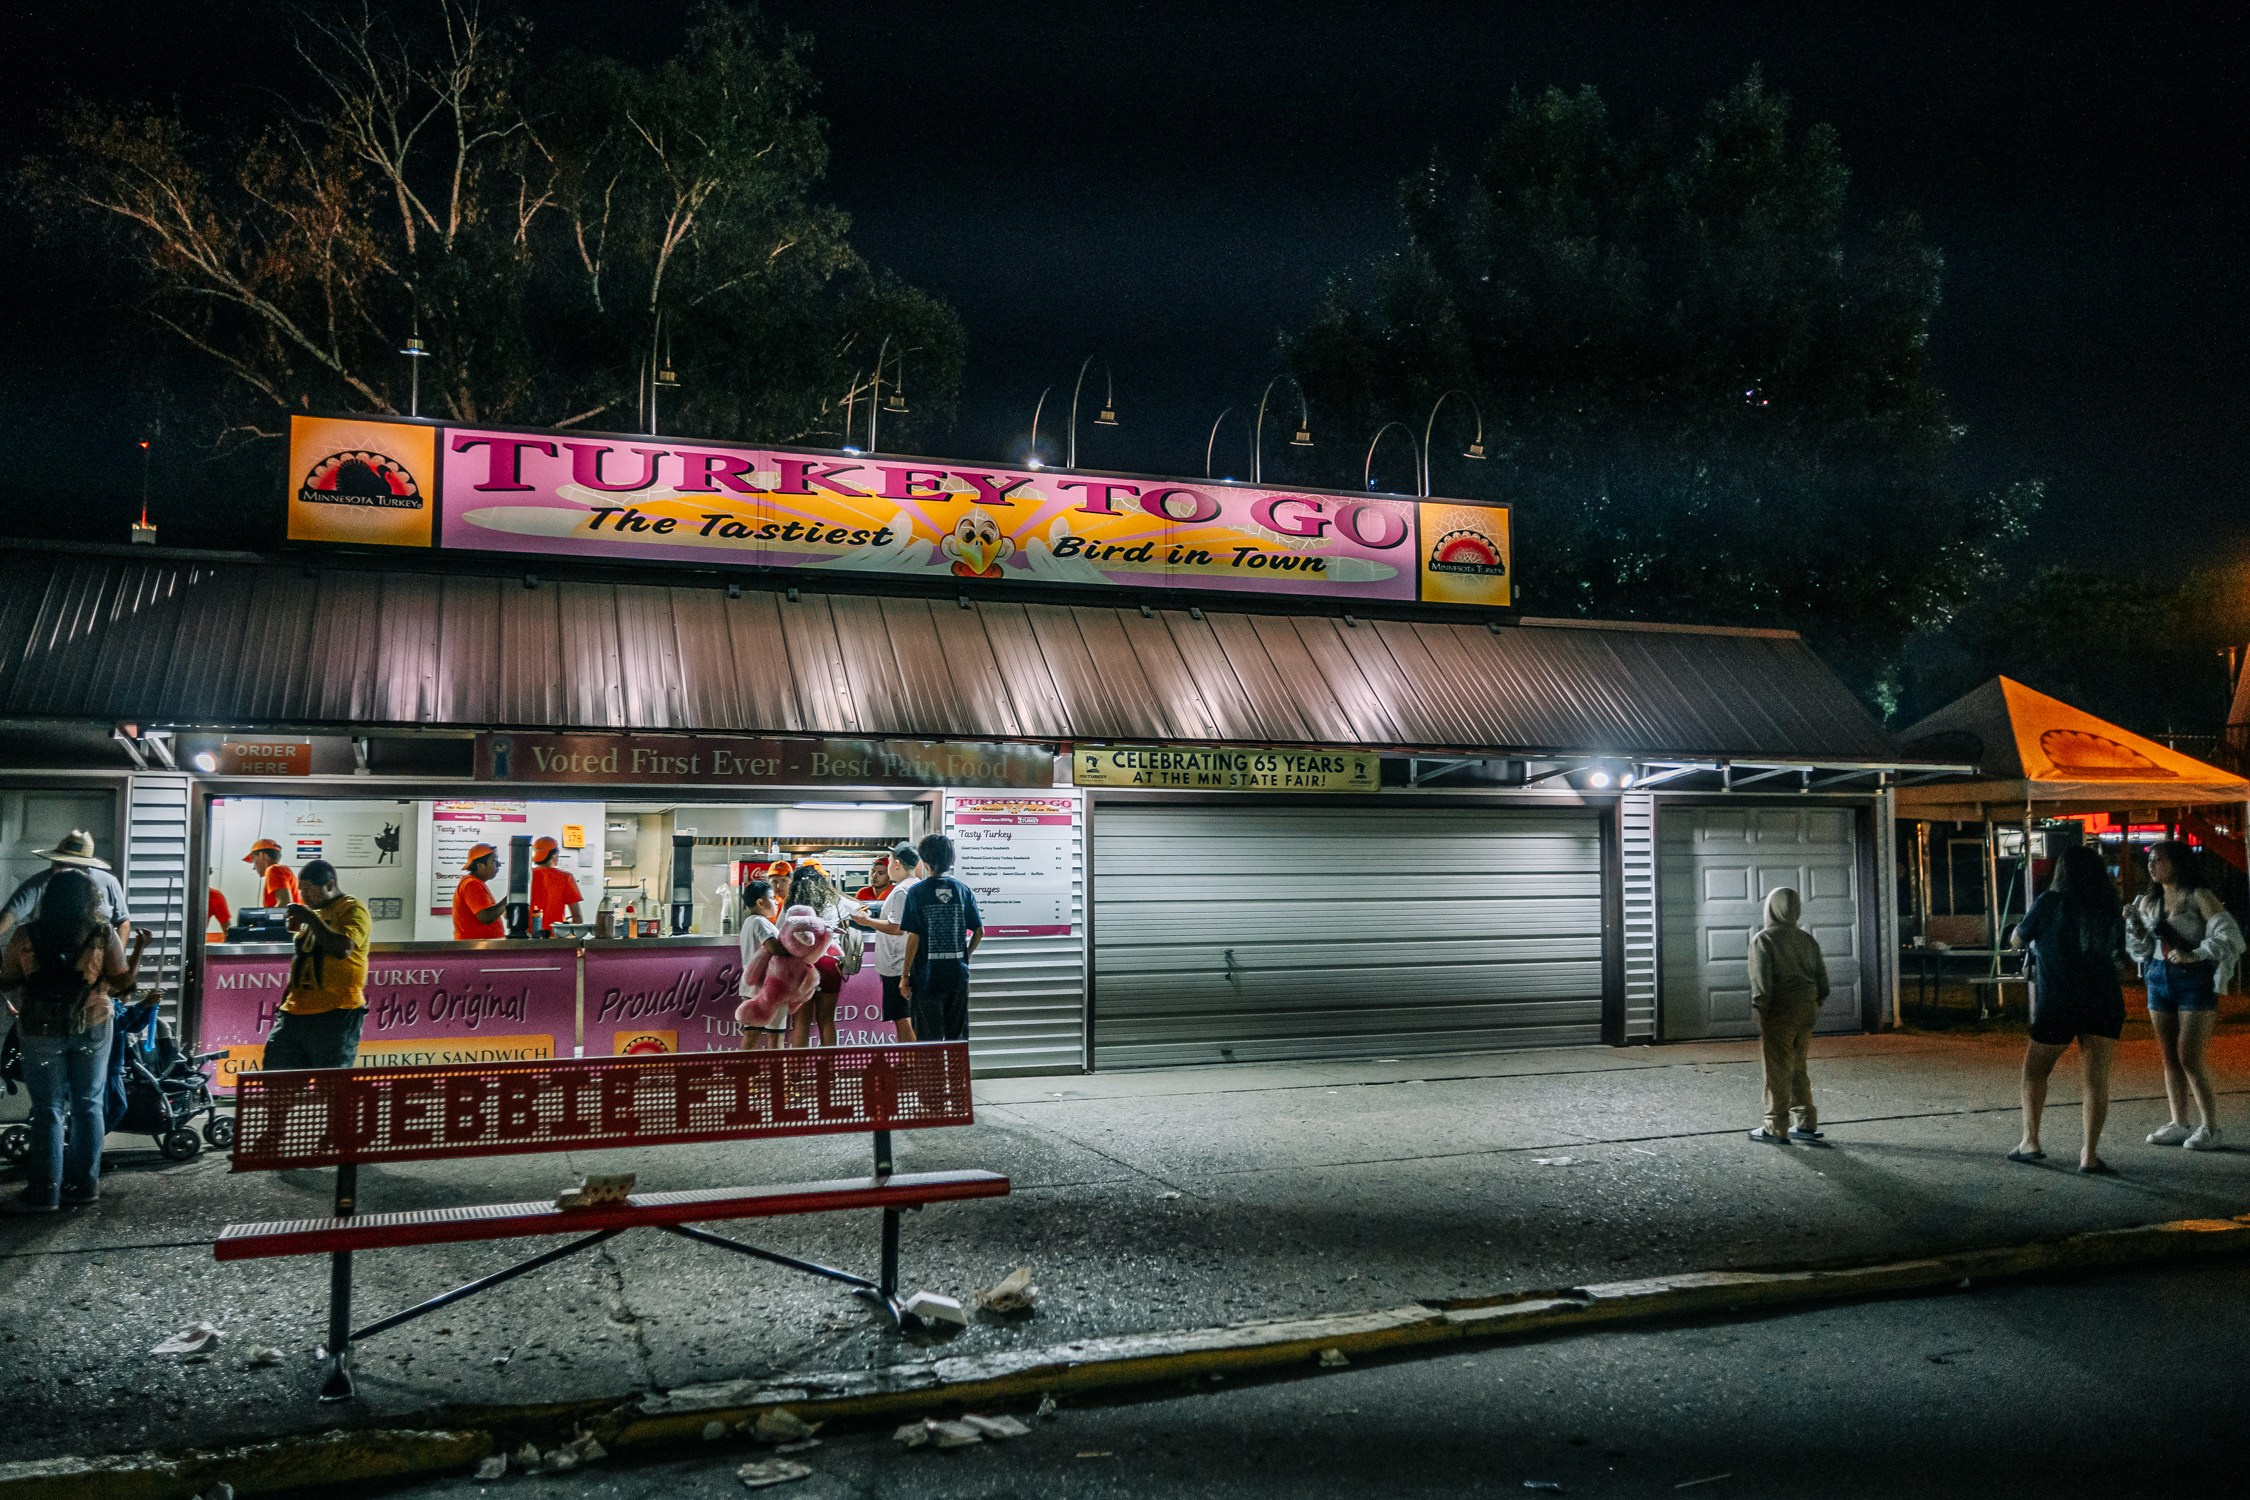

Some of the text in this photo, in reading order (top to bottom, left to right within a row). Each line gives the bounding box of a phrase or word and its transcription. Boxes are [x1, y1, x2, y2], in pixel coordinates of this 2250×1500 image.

[303, 491, 419, 508] MINNESOTA TURKEY
[452, 435, 1408, 549] TURKEY TO GO
[589, 507, 894, 547] The Tastiest
[1052, 536, 1327, 573] Bird in Town
[1431, 562, 1475, 573] MINNESOTA
[235, 745, 296, 757] ORDER
[241, 761, 288, 774] HERE
[531, 747, 618, 773] Voted
[631, 749, 700, 775] First
[711, 750, 780, 776] Ever
[810, 752, 872, 777] Best
[882, 753, 937, 778] Fair
[946, 754, 1009, 779] Food
[1112, 750, 1345, 773] CELEBRATING 65 YEARS
[1132, 771, 1326, 787] AT THE MN STATE FAIR!
[956, 799, 1021, 807] TURKEY
[1049, 800, 1072, 808] GO
[436, 825, 481, 835] Tasty Turkey
[959, 829, 1012, 841] Tasty Turkey
[972, 887, 1000, 896] erages
[216, 972, 291, 989] MINN
[598, 969, 705, 1023] Proudly
[376, 984, 531, 1031] the Original
[834, 1005, 858, 1021] ED
[864, 1004, 884, 1021] O
[836, 1028, 897, 1046] FARMS
[359, 1052, 439, 1068] TURKEY
[442, 1047, 548, 1065] SANDWICH
[344, 1066, 641, 1147] DEBBIE
